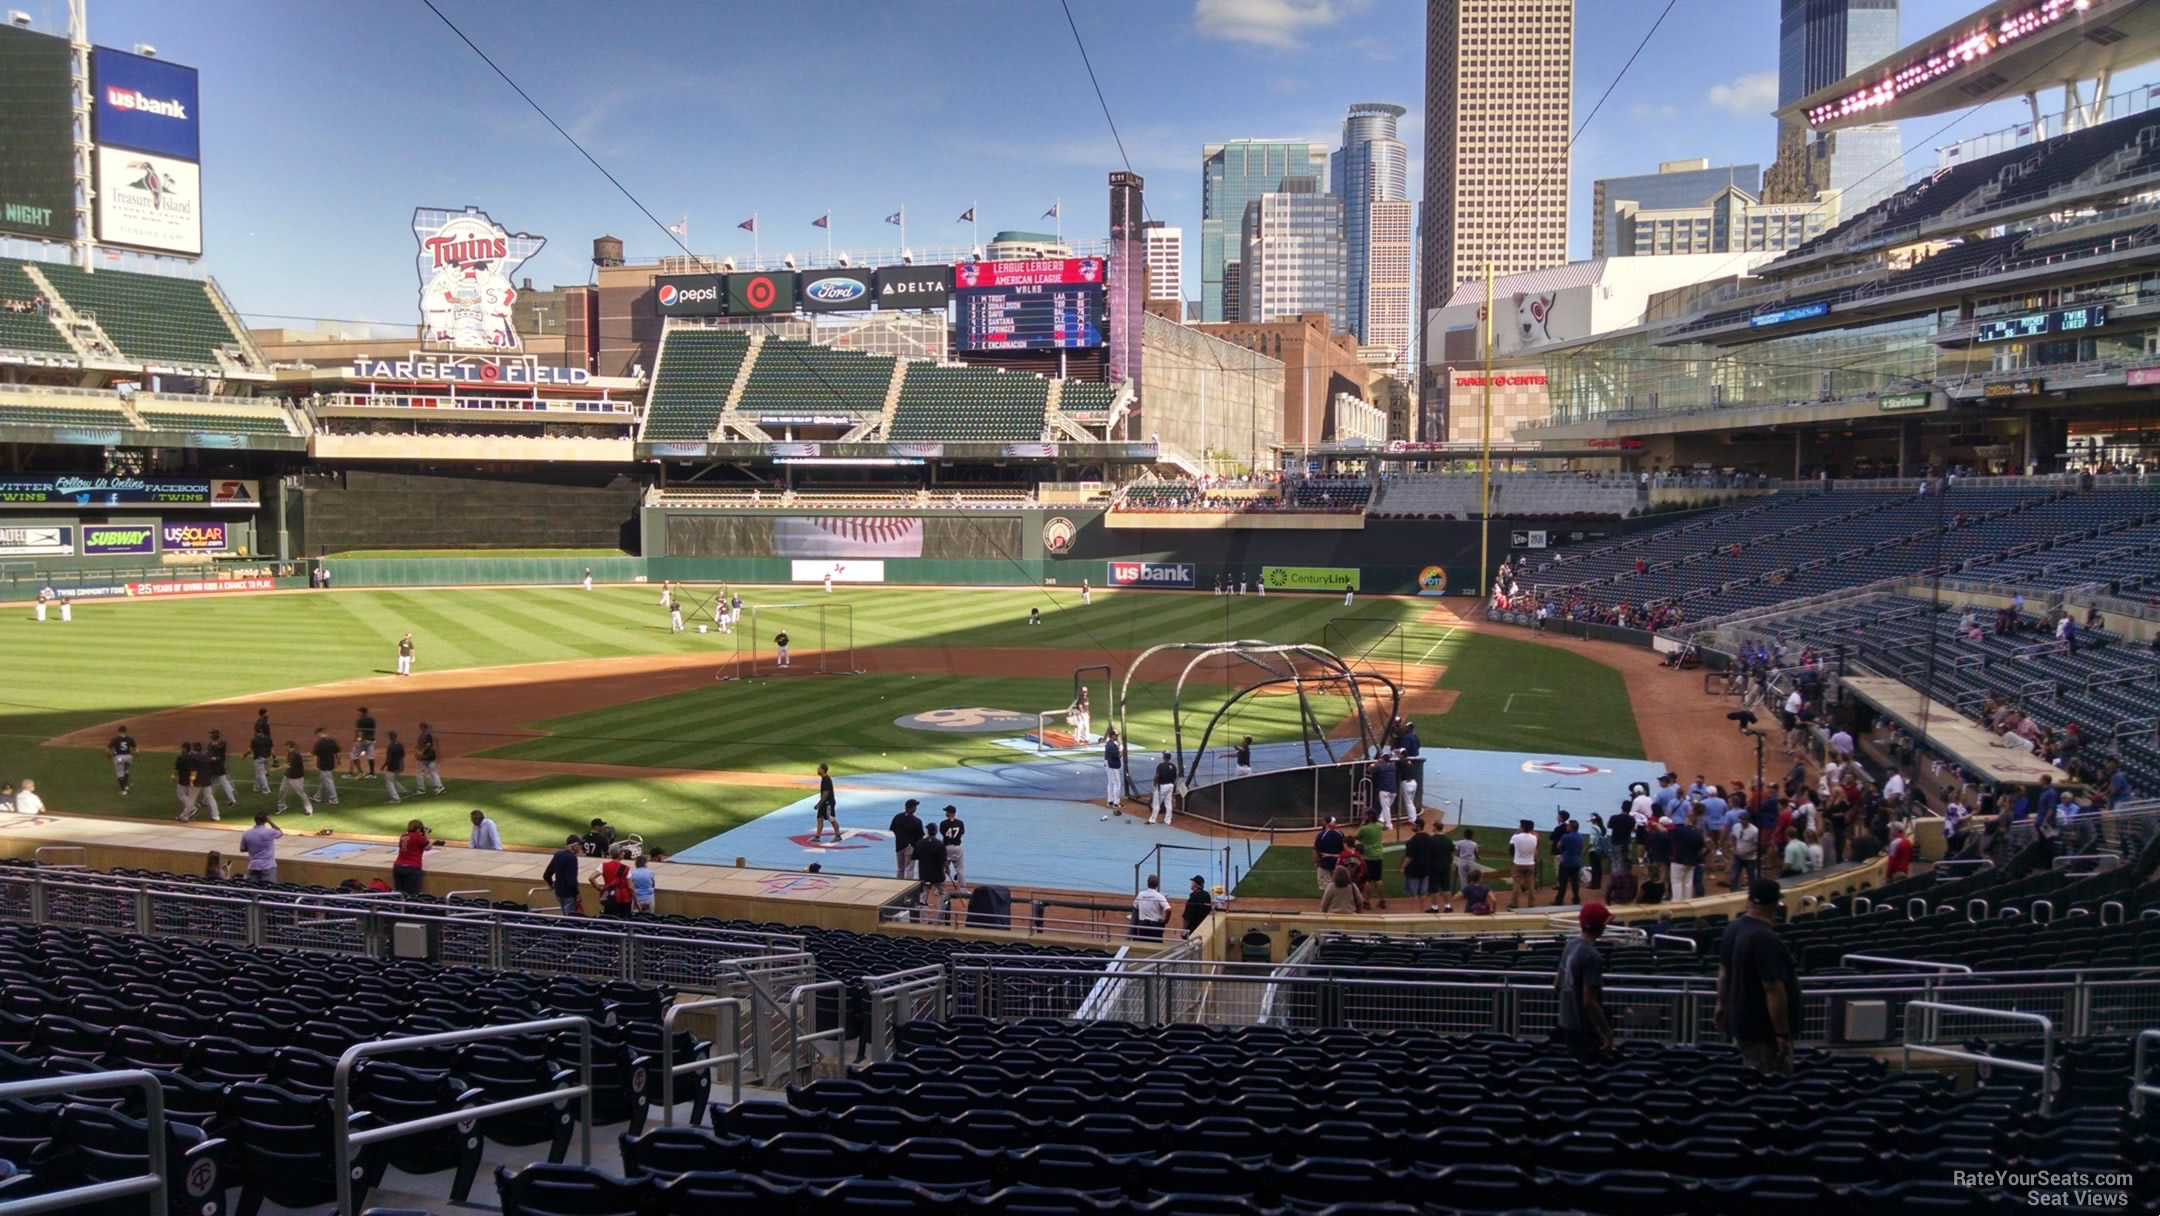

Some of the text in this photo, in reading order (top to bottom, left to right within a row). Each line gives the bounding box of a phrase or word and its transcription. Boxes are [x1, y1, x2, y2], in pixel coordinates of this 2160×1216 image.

[110, 187, 191, 213] Treasure Island
[6, 203, 53, 227] NIGHT
[425, 232, 507, 270] Twins
[993, 260, 1064, 274] LEAGUE LEADERS
[995, 273, 1063, 286] AMERICAN LEAGUE
[817, 281, 853, 299] Ford
[897, 280, 944, 293] DELTA
[679, 286, 717, 303] pepsi
[354, 360, 590, 385] TARGET FIELD
[1506, 376, 1548, 386] CENTER
[56, 477, 93, 490] Follow
[111, 477, 145, 489] Online
[145, 484, 209, 493] FACEBOOK
[158, 493, 204, 502] TWINS
[87, 530, 151, 546] SUBWAY
[1115, 563, 1190, 581] usbank
[1290, 571, 1351, 585] CenturyLink
[137, 583, 152, 594] 25
[152, 583, 173, 593] YEARS
[120, 742, 128, 751] 5
[945, 827, 960, 839] 47
[583, 842, 597, 854] 97
